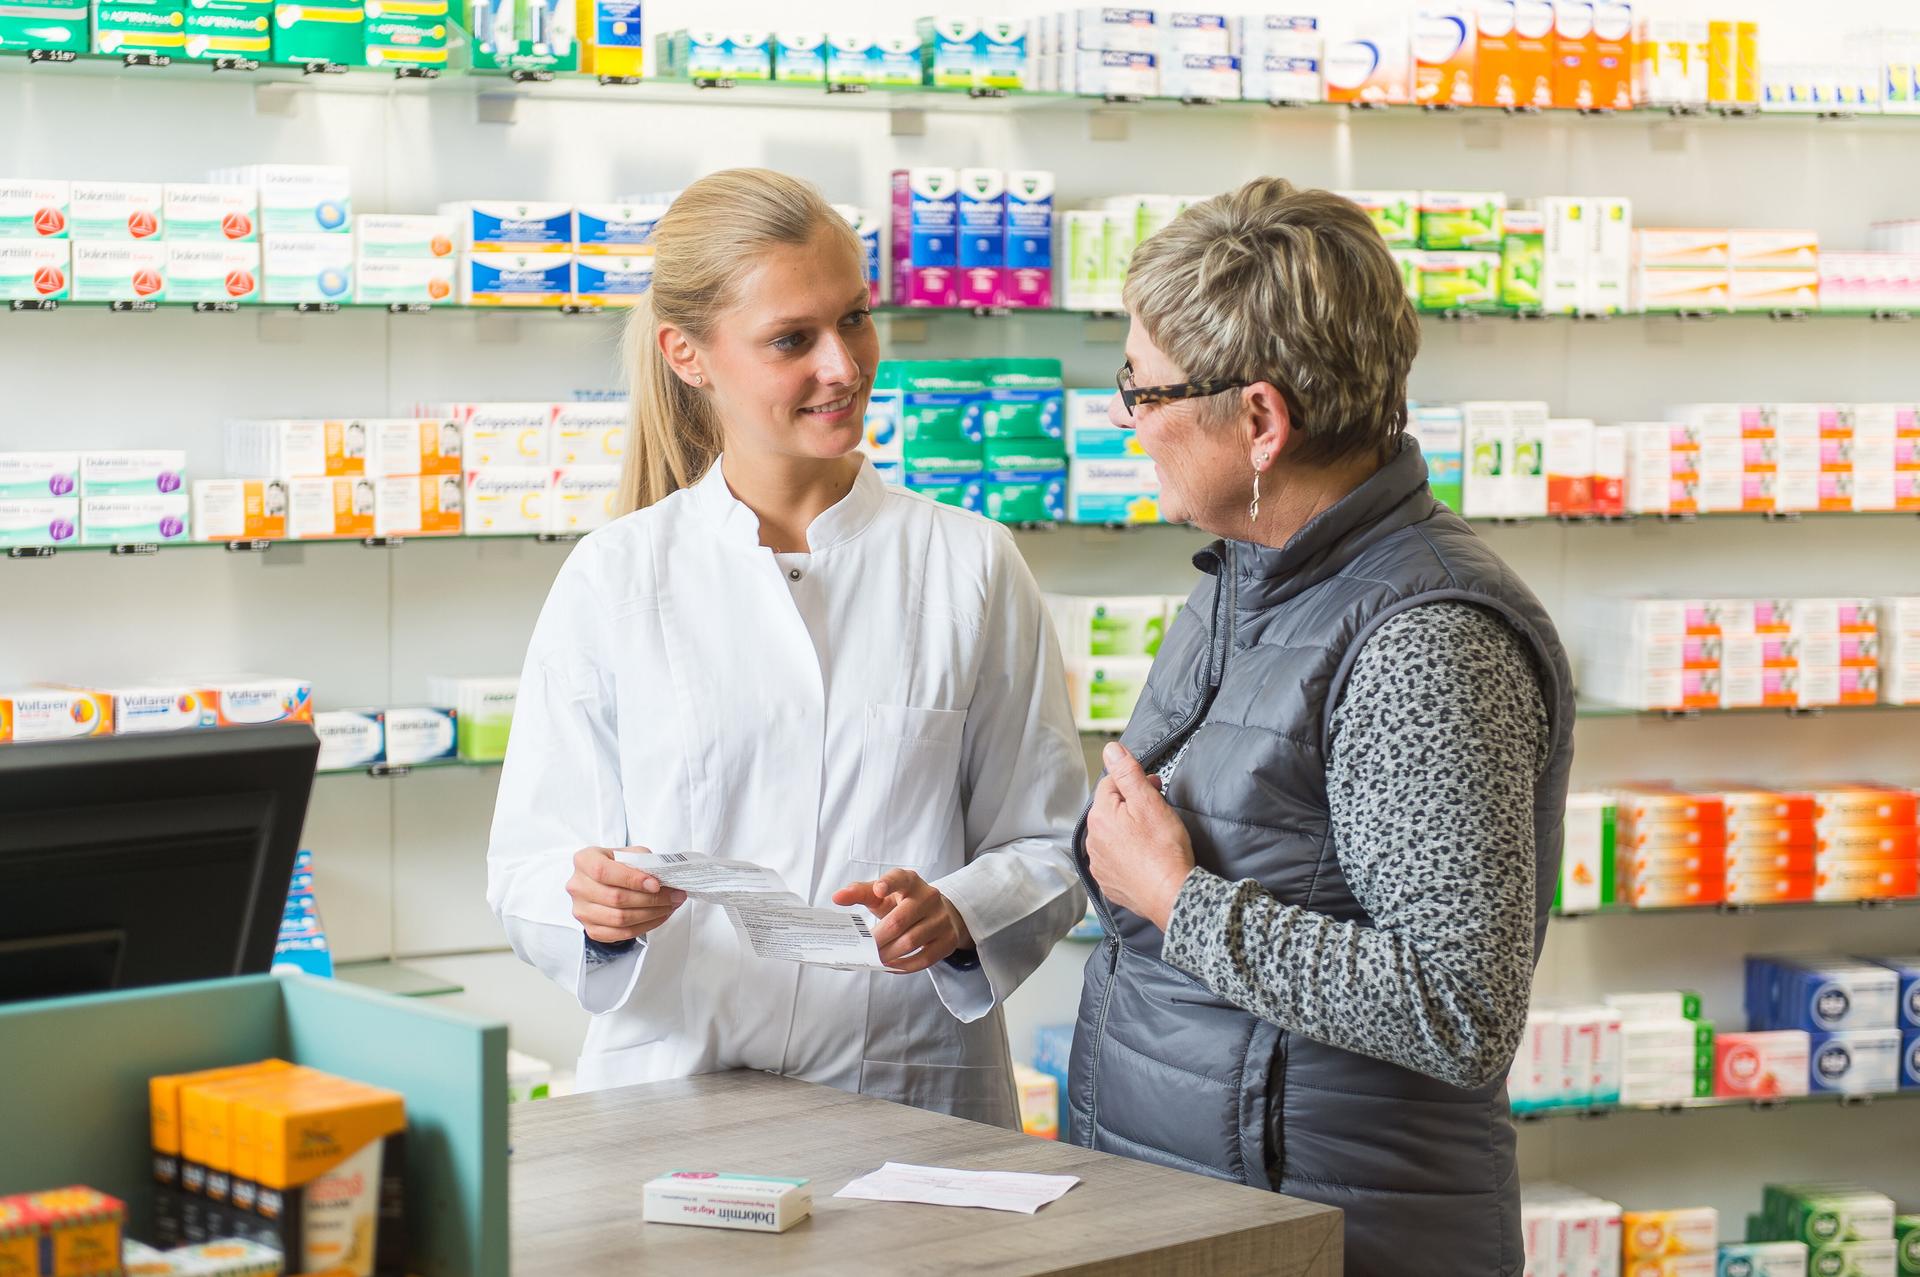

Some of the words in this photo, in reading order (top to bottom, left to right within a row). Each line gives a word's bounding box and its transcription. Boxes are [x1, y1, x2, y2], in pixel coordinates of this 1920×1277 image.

[17, 700, 68, 711] Voltaren
[123, 695, 175, 707] Voltaren
[682, 1203, 716, 1216] Migräne
[719, 1208, 776, 1225] Dolormin
